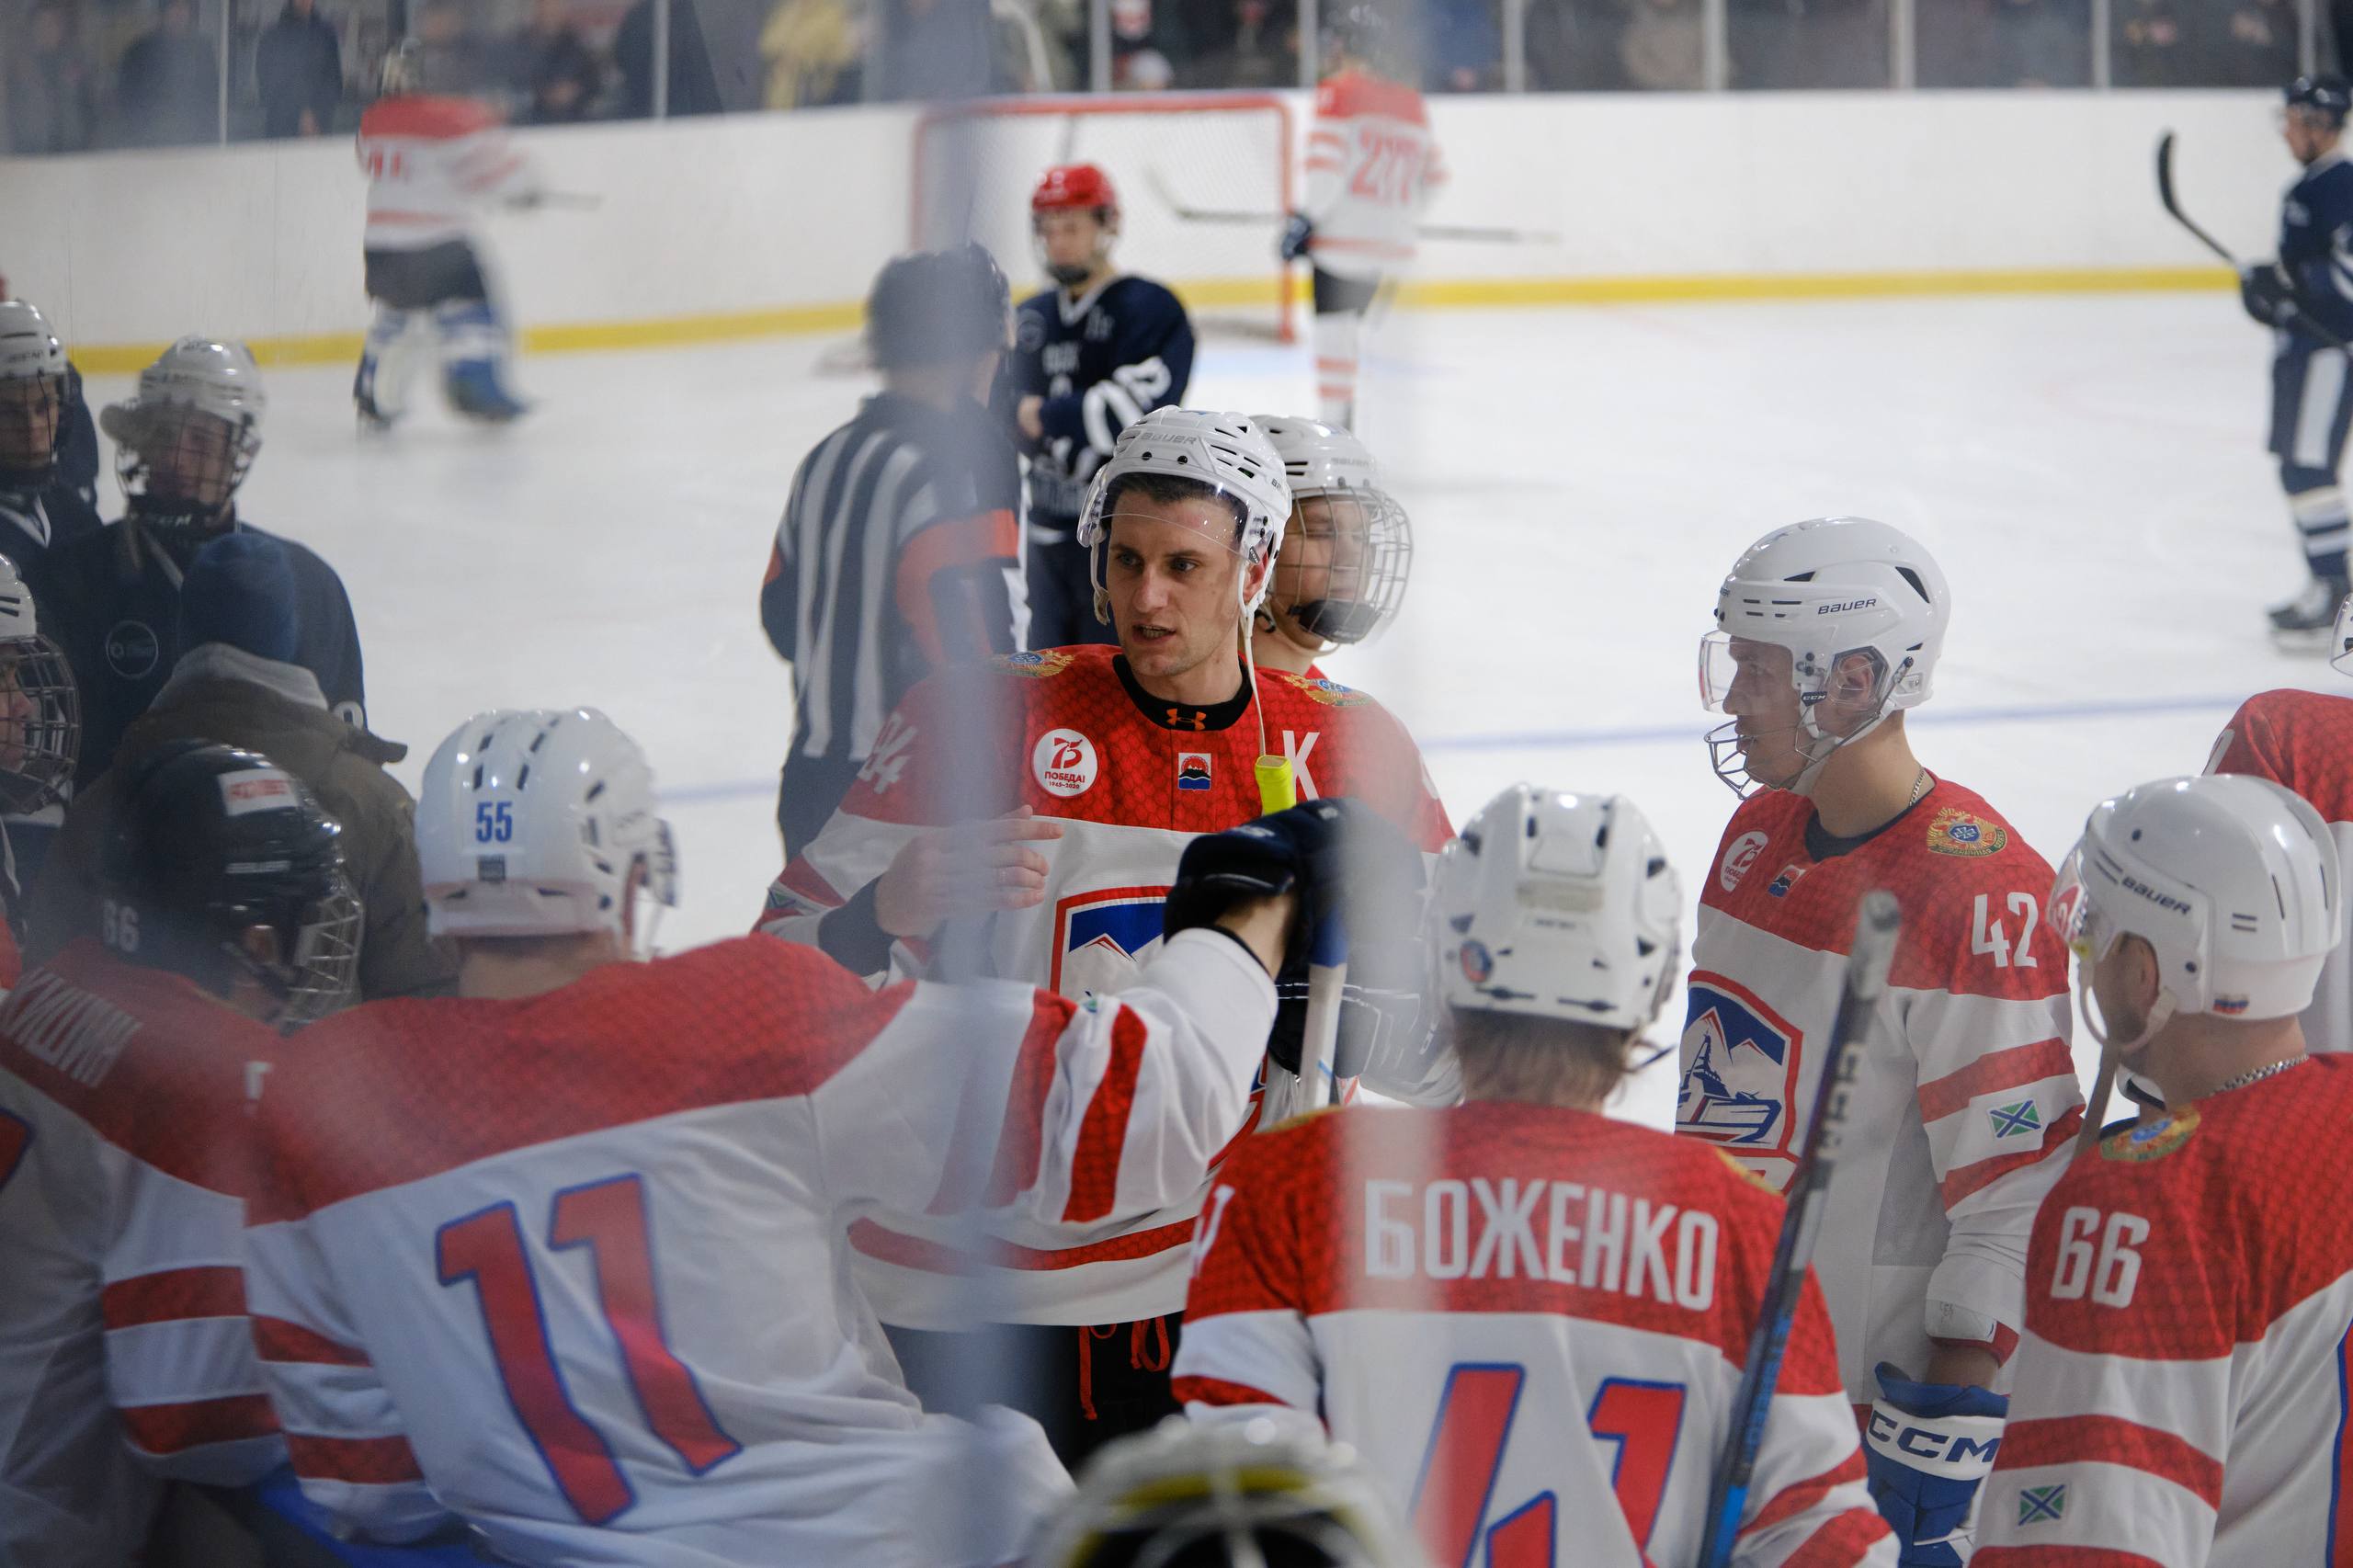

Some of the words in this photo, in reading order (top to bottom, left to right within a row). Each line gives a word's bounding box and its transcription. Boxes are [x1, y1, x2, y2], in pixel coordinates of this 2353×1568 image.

[1817, 598, 1877, 615] BAUER
[1044, 771, 1086, 783] ПОБЕДА!
[475, 801, 514, 844] 55
[2122, 876, 2191, 915] BAUER
[1972, 892, 2039, 968] 42
[1365, 1177, 1719, 1312] БОЖЕНКО
[2050, 1206, 2151, 1309] 66
[435, 1172, 743, 1528] 11
[1869, 1409, 2001, 1463] CCM
